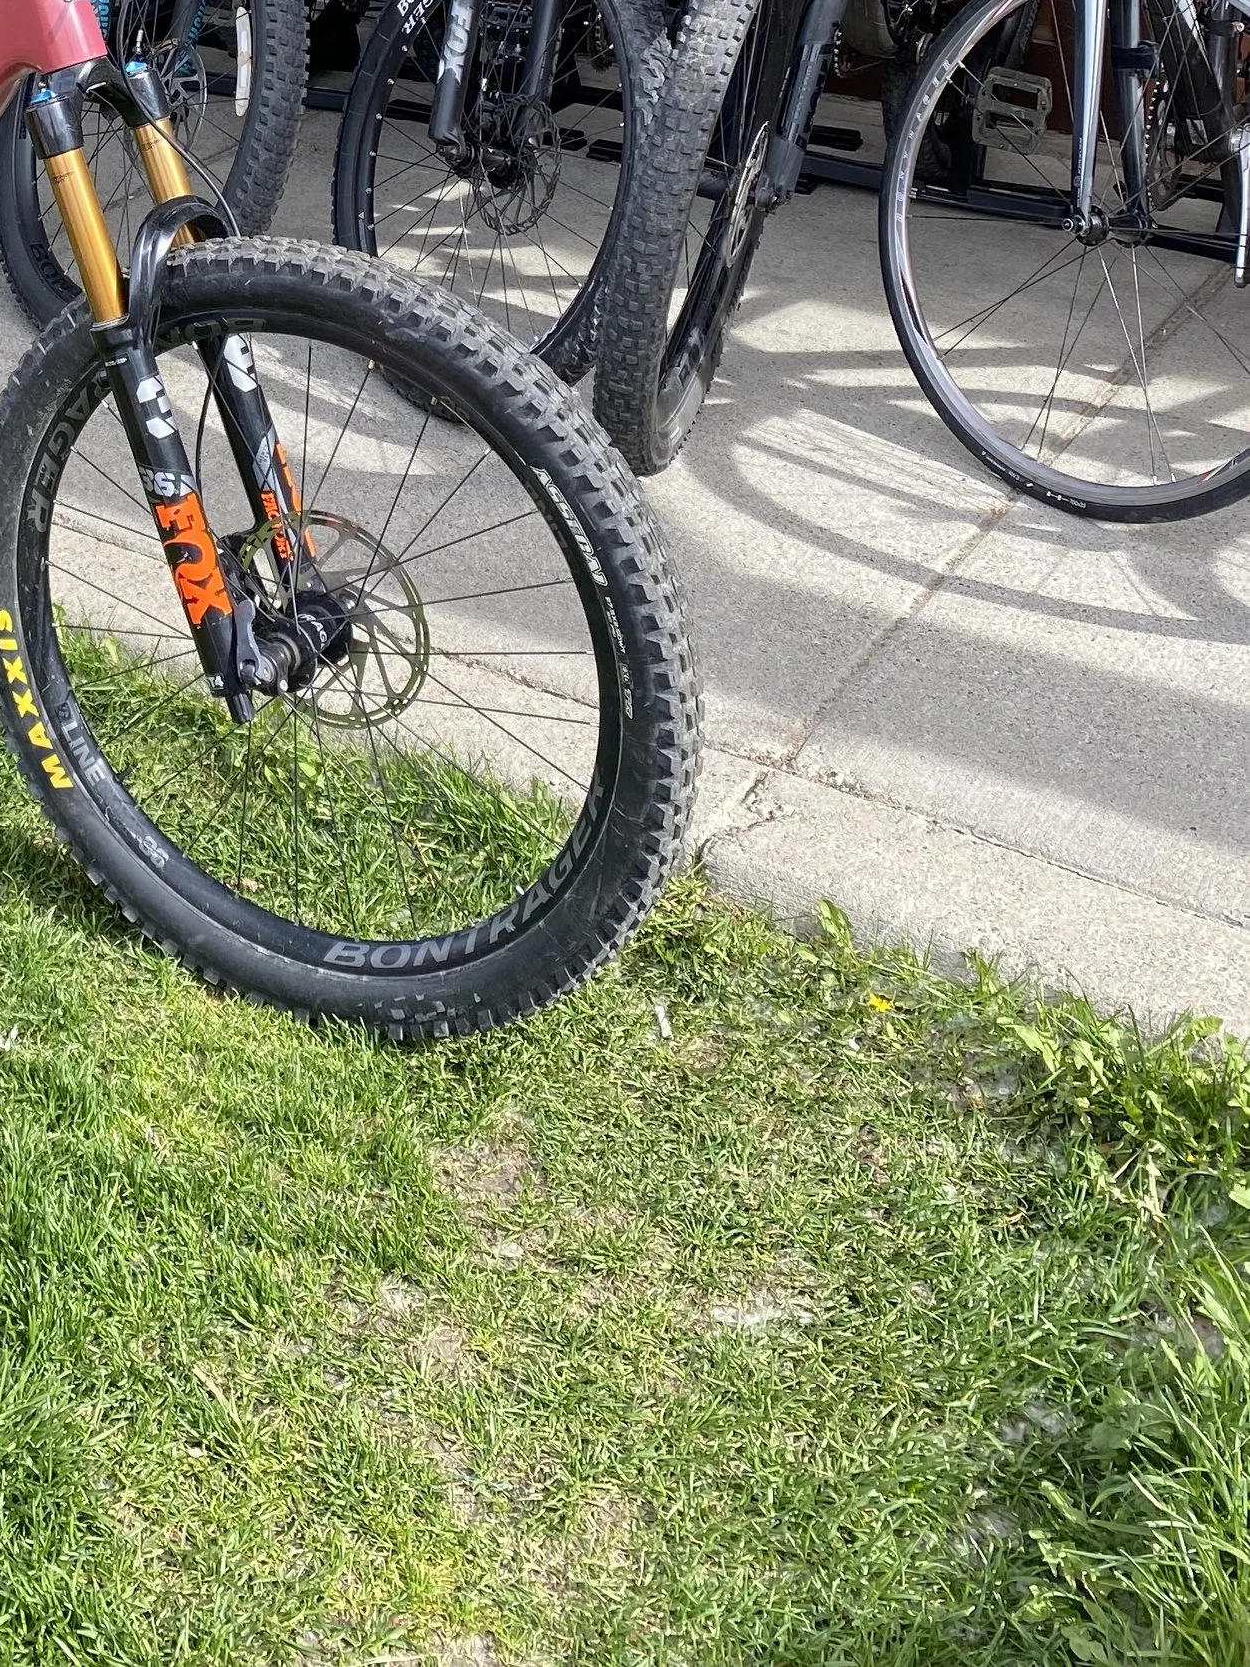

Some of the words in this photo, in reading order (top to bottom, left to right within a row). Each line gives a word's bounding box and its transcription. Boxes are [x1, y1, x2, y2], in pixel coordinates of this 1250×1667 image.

[154, 491, 234, 627] FOX
[60, 719, 107, 784] LINE
[322, 783, 605, 970] BONTRAGER
